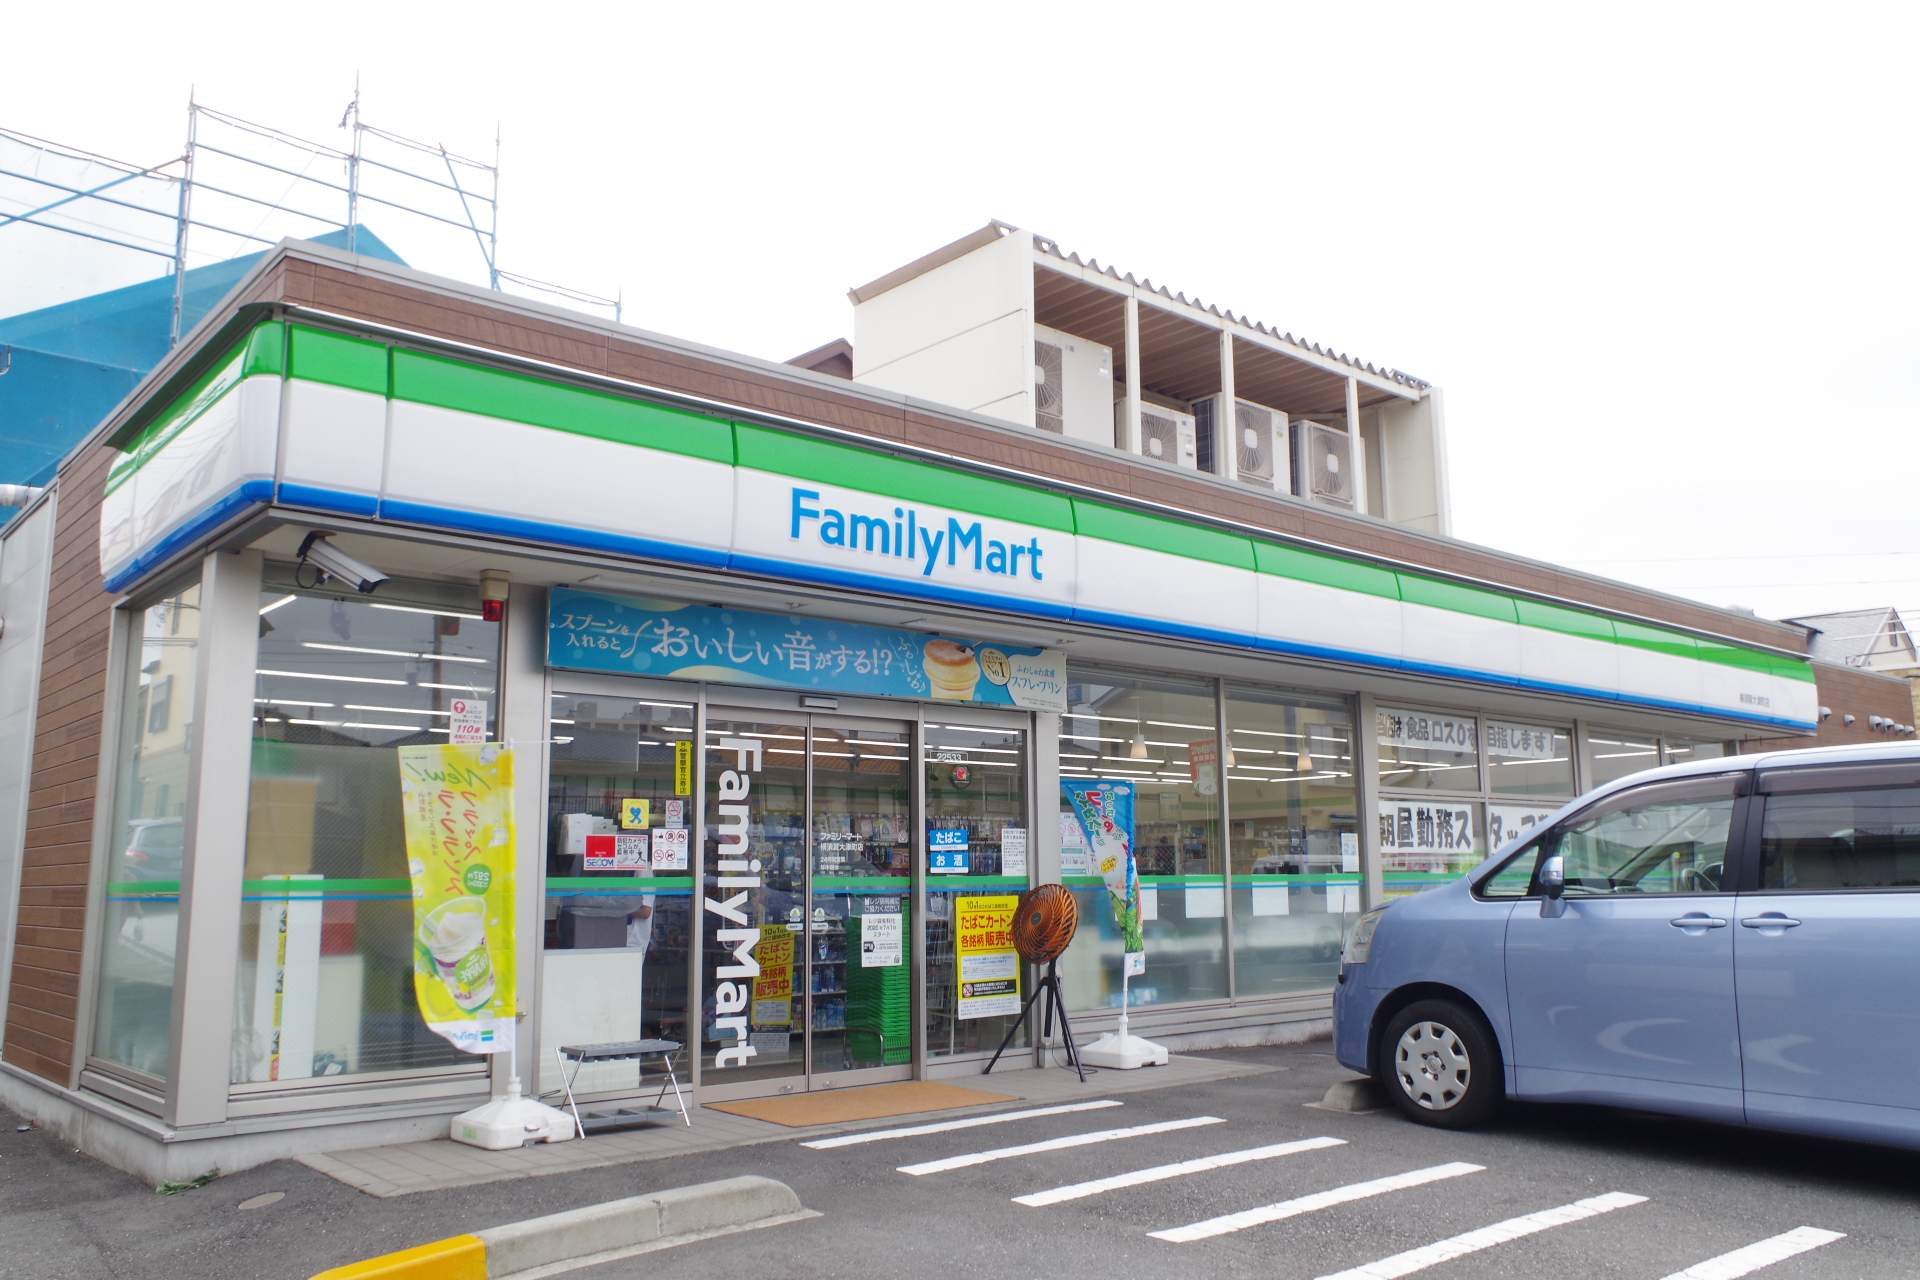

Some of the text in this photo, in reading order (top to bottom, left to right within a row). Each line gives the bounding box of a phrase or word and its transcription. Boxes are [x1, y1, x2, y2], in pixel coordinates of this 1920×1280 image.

[790, 487, 1044, 582] FamilyMart
[566, 633, 621, 651] 入れると
[819, 832, 863, 842] ファミリーマート
[936, 831, 963, 845] たばこ
[586, 858, 615, 867] SECOM
[936, 854, 964, 867] お酒
[704, 736, 763, 1069] FamilyMart
